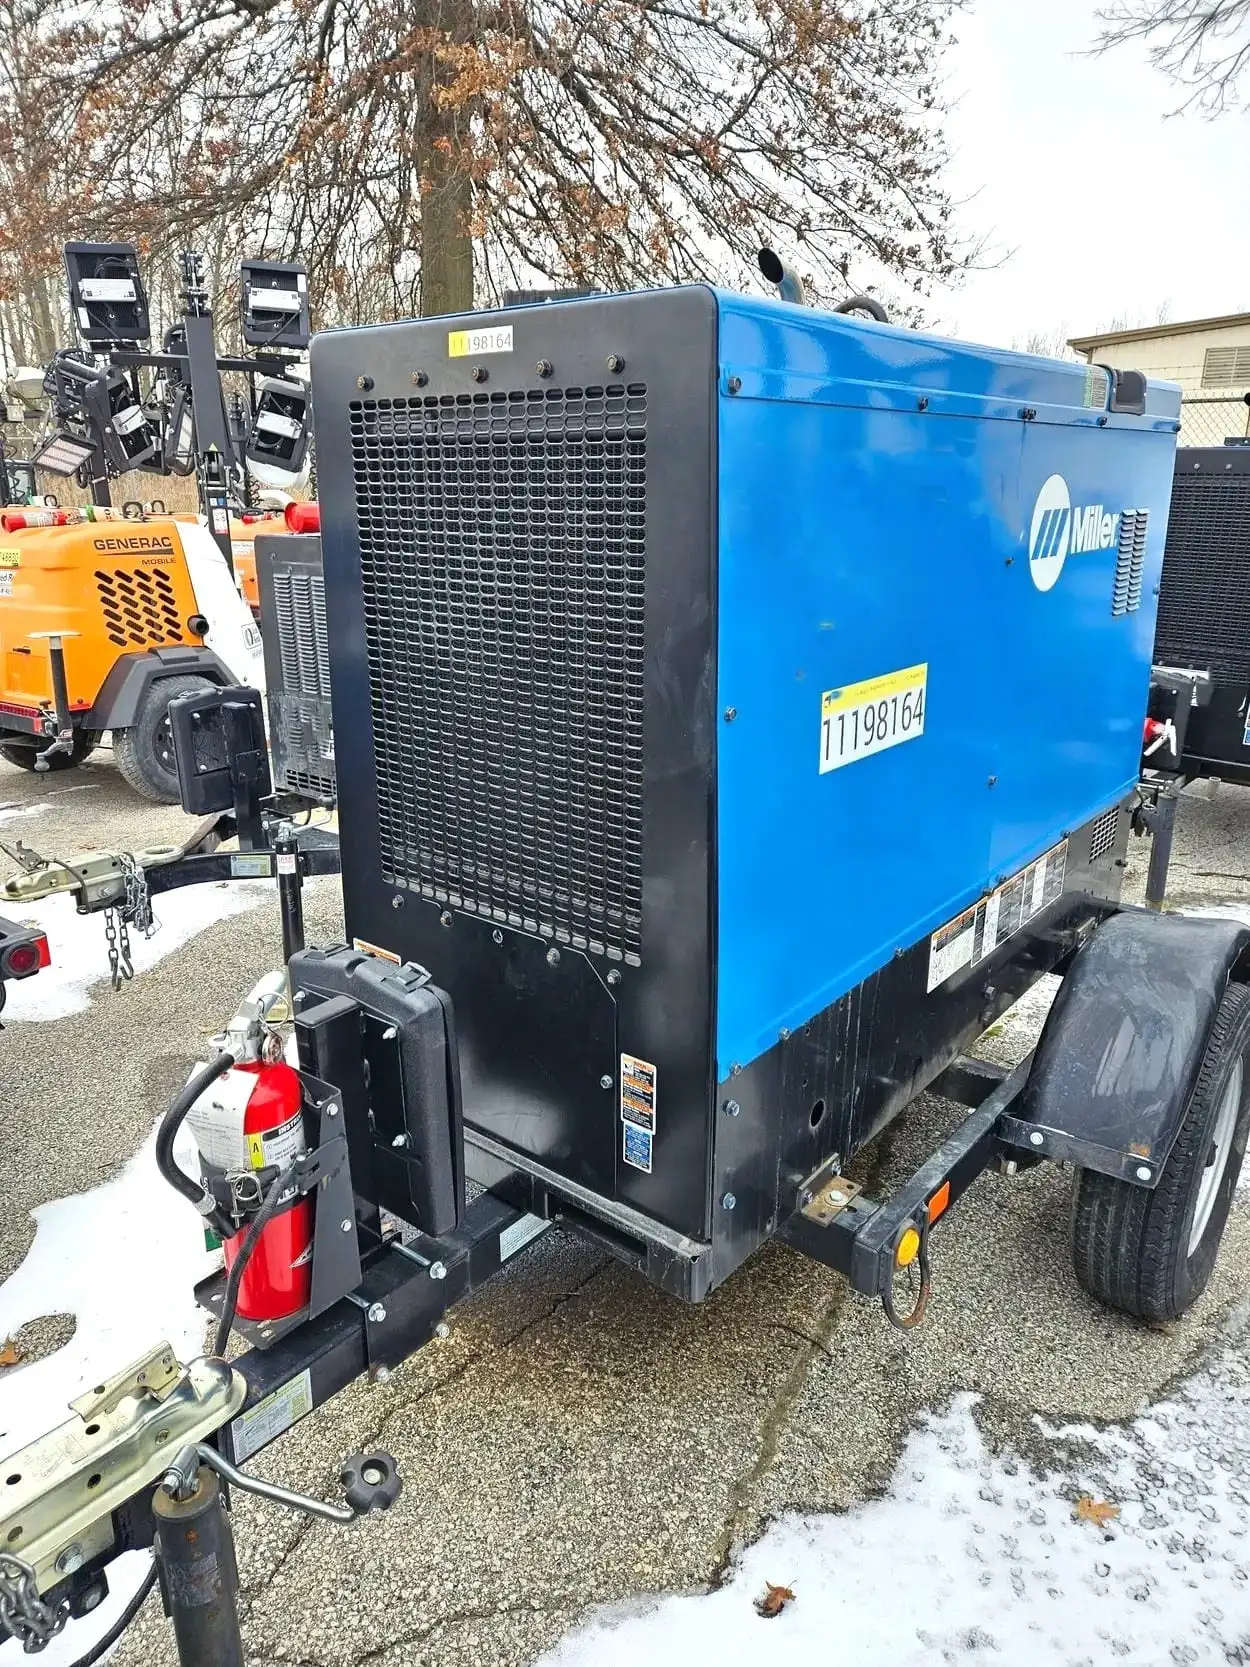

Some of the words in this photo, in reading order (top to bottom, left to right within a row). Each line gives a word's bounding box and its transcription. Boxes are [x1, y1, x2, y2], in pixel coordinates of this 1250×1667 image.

[453, 333, 511, 352] 11198164
[94, 536, 172, 551] GENERAC
[142, 558, 176, 566] MOBILE
[823, 687, 923, 761] 11198164
[252, 1142, 260, 1153] A
